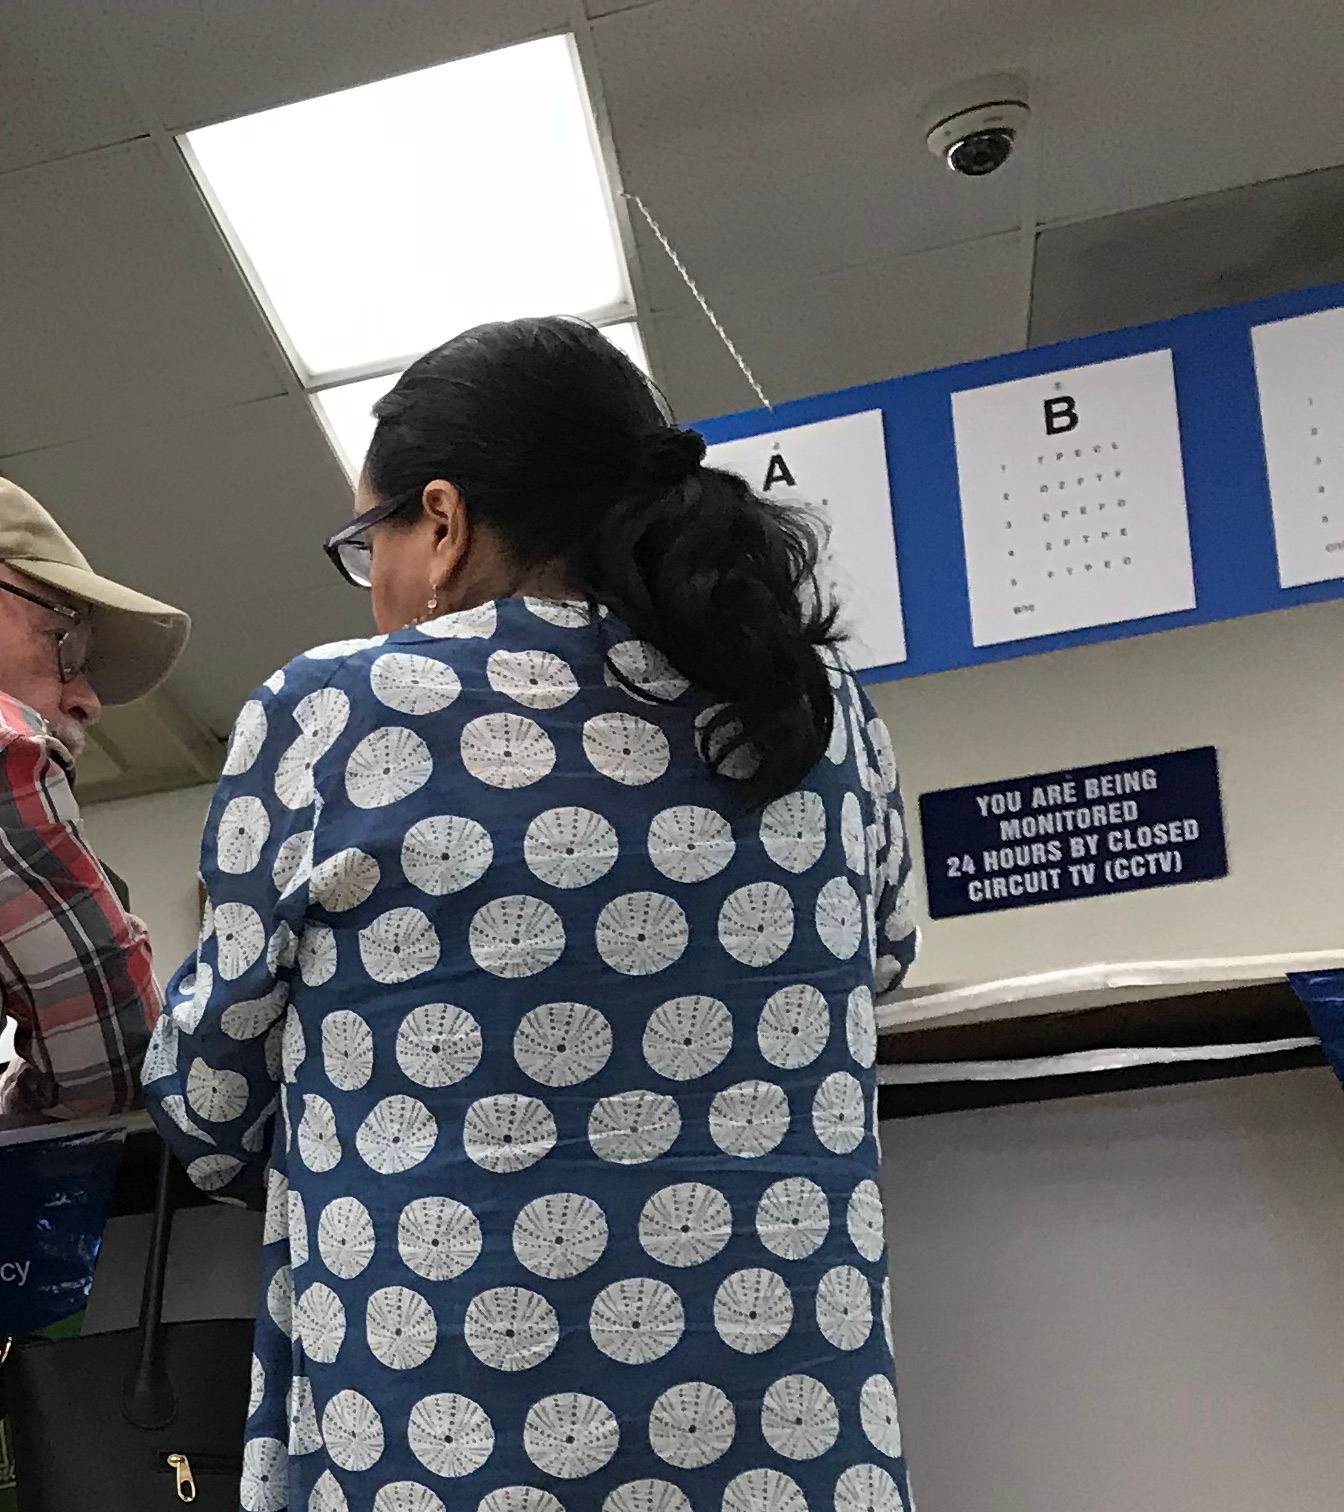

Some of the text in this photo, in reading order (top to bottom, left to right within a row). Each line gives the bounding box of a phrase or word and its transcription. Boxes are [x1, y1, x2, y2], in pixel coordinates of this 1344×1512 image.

[1044, 396, 1079, 435] B
[763, 454, 797, 491] A
[976, 769, 1158, 817] YOU ARE BEING
[1000, 800, 1138, 842] MONITORED
[946, 819, 1199, 877] 24 HOURS BY CLOSED
[968, 851, 1182, 901] CIRCUIT TV (CCTV)
